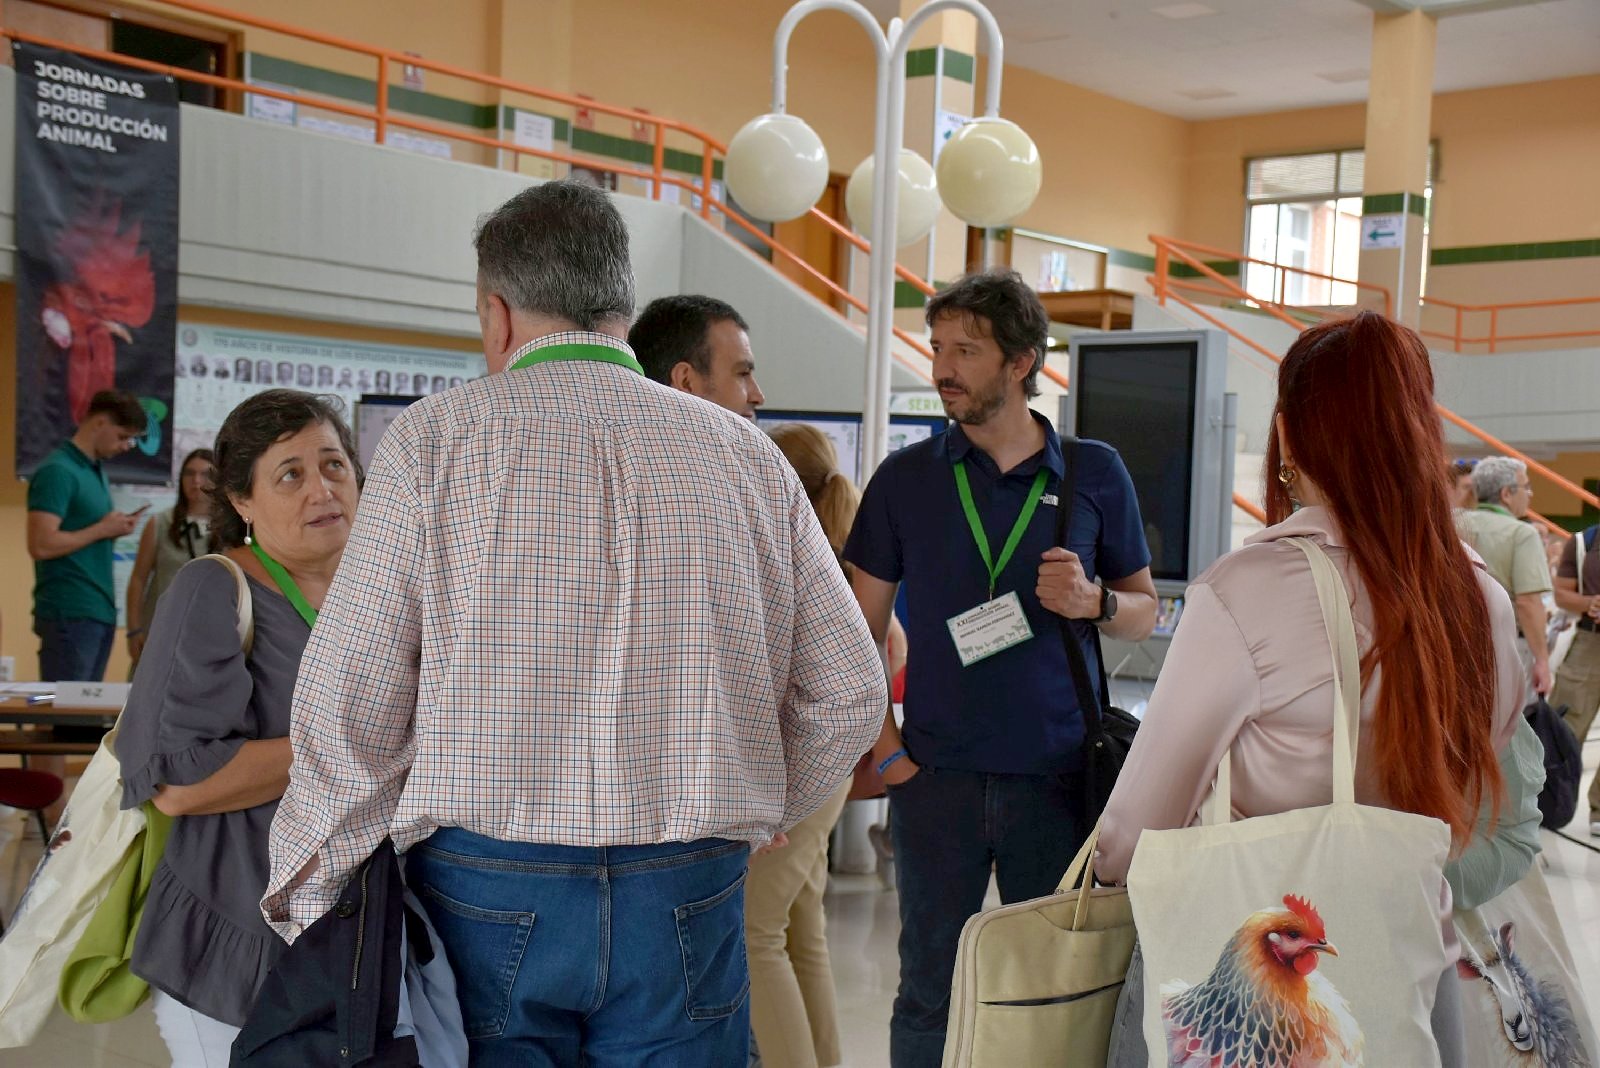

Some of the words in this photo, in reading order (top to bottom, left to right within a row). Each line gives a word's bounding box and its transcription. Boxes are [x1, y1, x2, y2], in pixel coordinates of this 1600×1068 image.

[34, 60, 146, 99] JORNADAS
[37, 80, 107, 110] SOBRE
[37, 101, 168, 142] PRODUCCIÓN
[37, 122, 117, 153] ANIMAL
[260, 341, 272, 352] DE
[321, 347, 333, 357] DE
